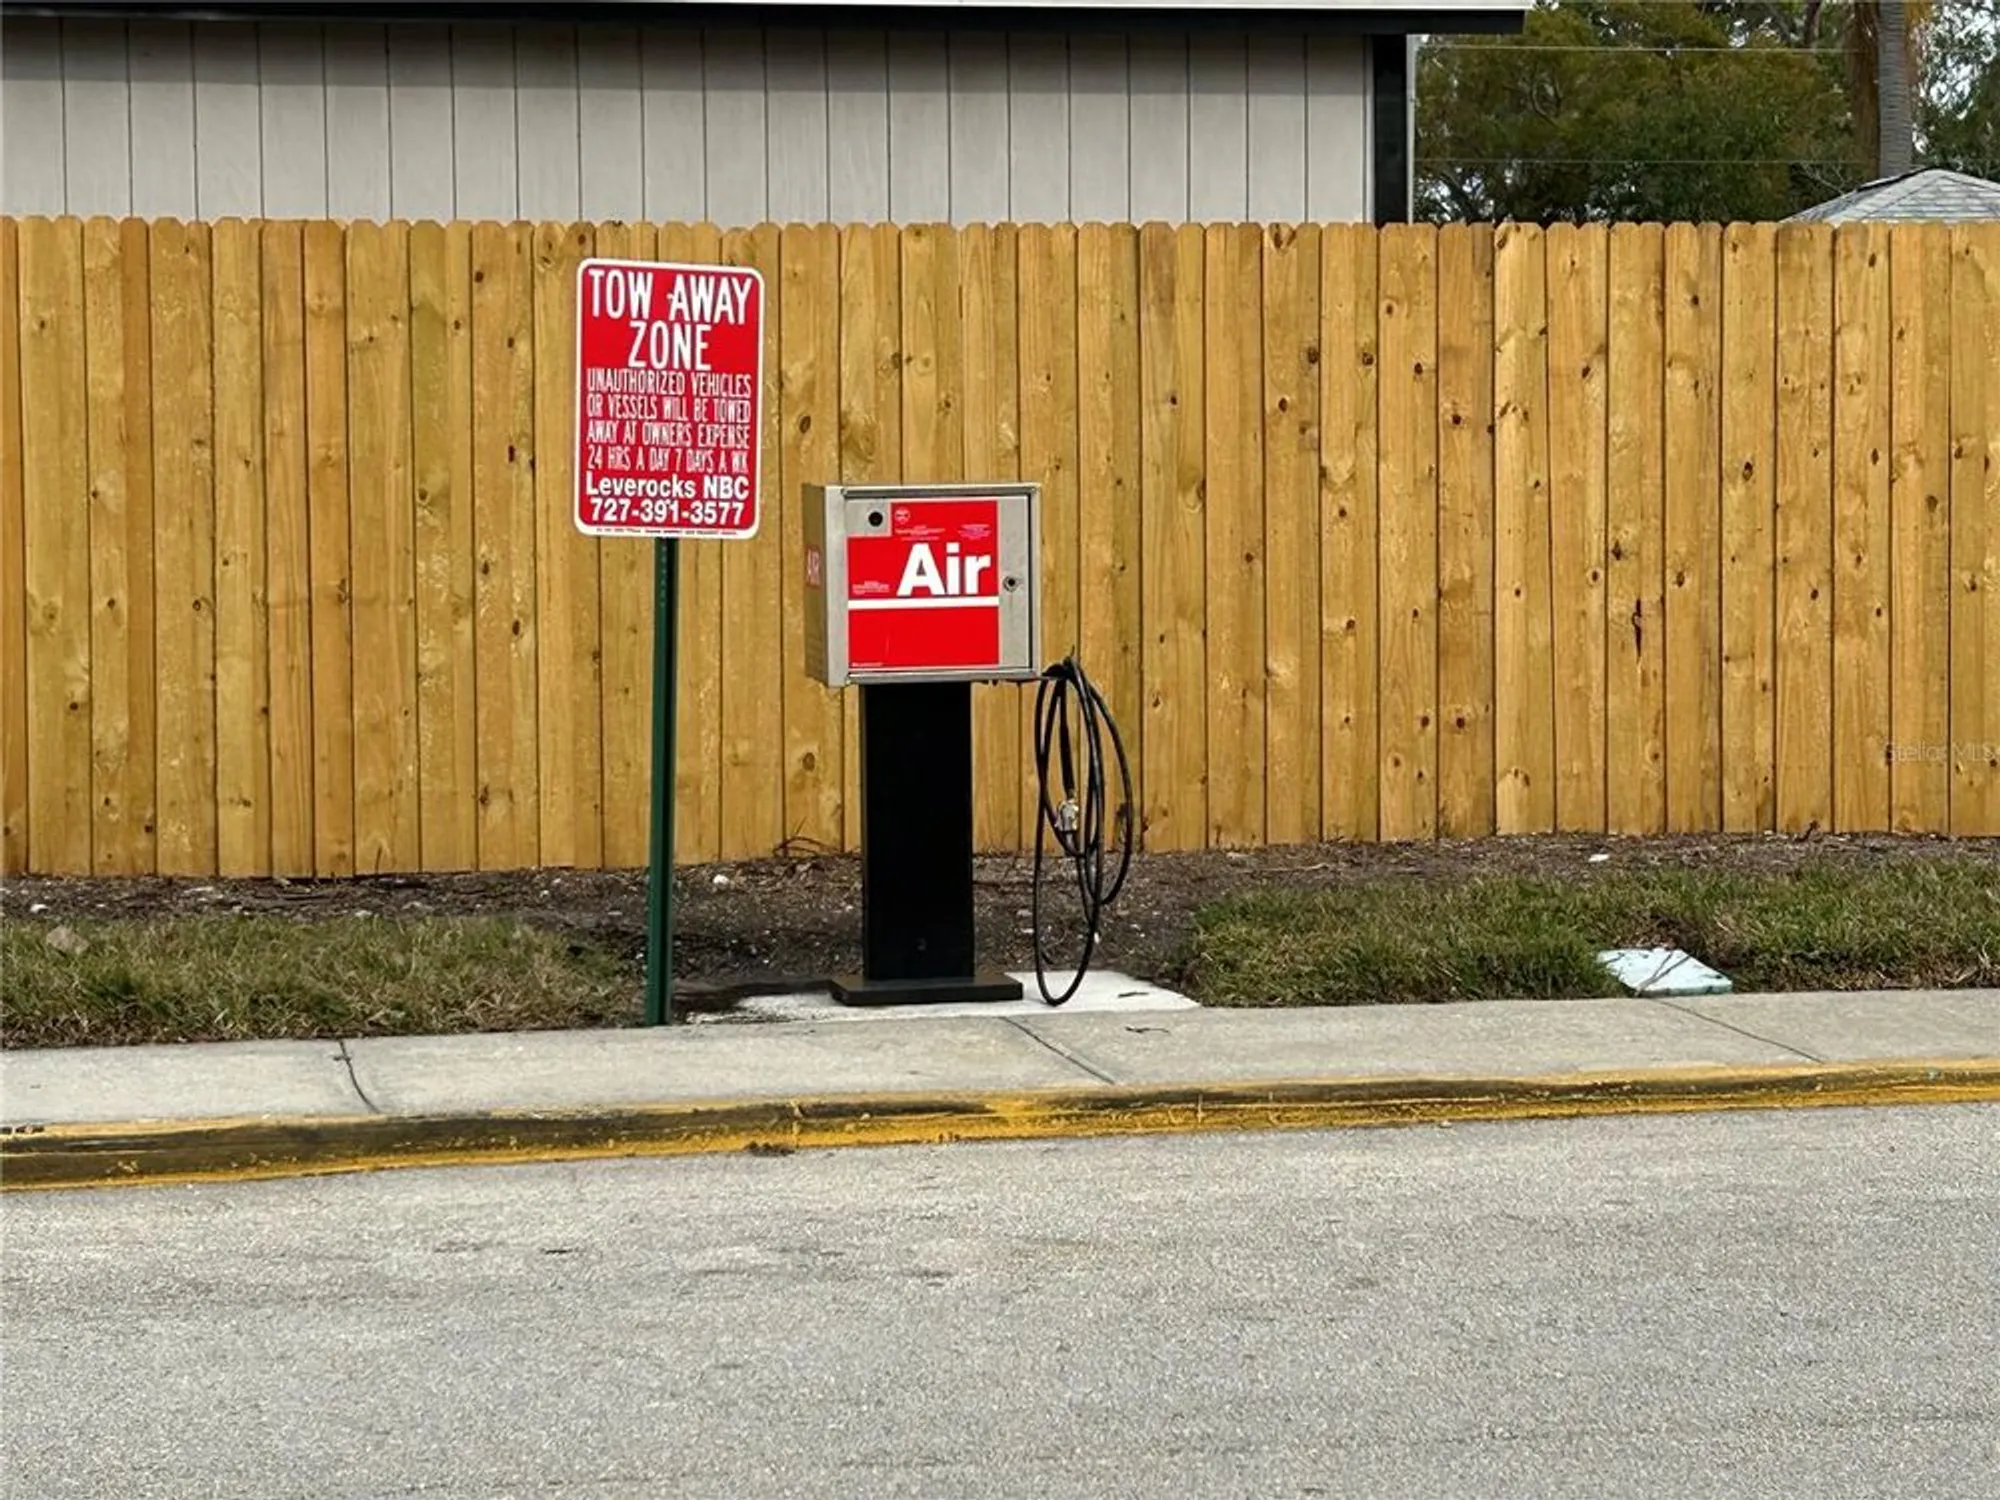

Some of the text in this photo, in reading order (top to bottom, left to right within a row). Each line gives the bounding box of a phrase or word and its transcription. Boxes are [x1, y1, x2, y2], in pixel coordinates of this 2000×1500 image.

[588, 269, 752, 325] TOW AWAY
[628, 320, 712, 370] ZONE
[587, 368, 752, 397] UNAUTHORIZED VEHICLES
[587, 394, 751, 423] OR VESSELS WILL BE TOWED
[586, 419, 750, 449] AWAY AT OWNERS EXPENSE
[588, 445, 749, 475] 24 HRS A DAY 7 DAYS A WK
[586, 471, 749, 500] Leverocks NBC
[590, 498, 745, 525] 727-391-3577
[896, 542, 992, 597] Air
